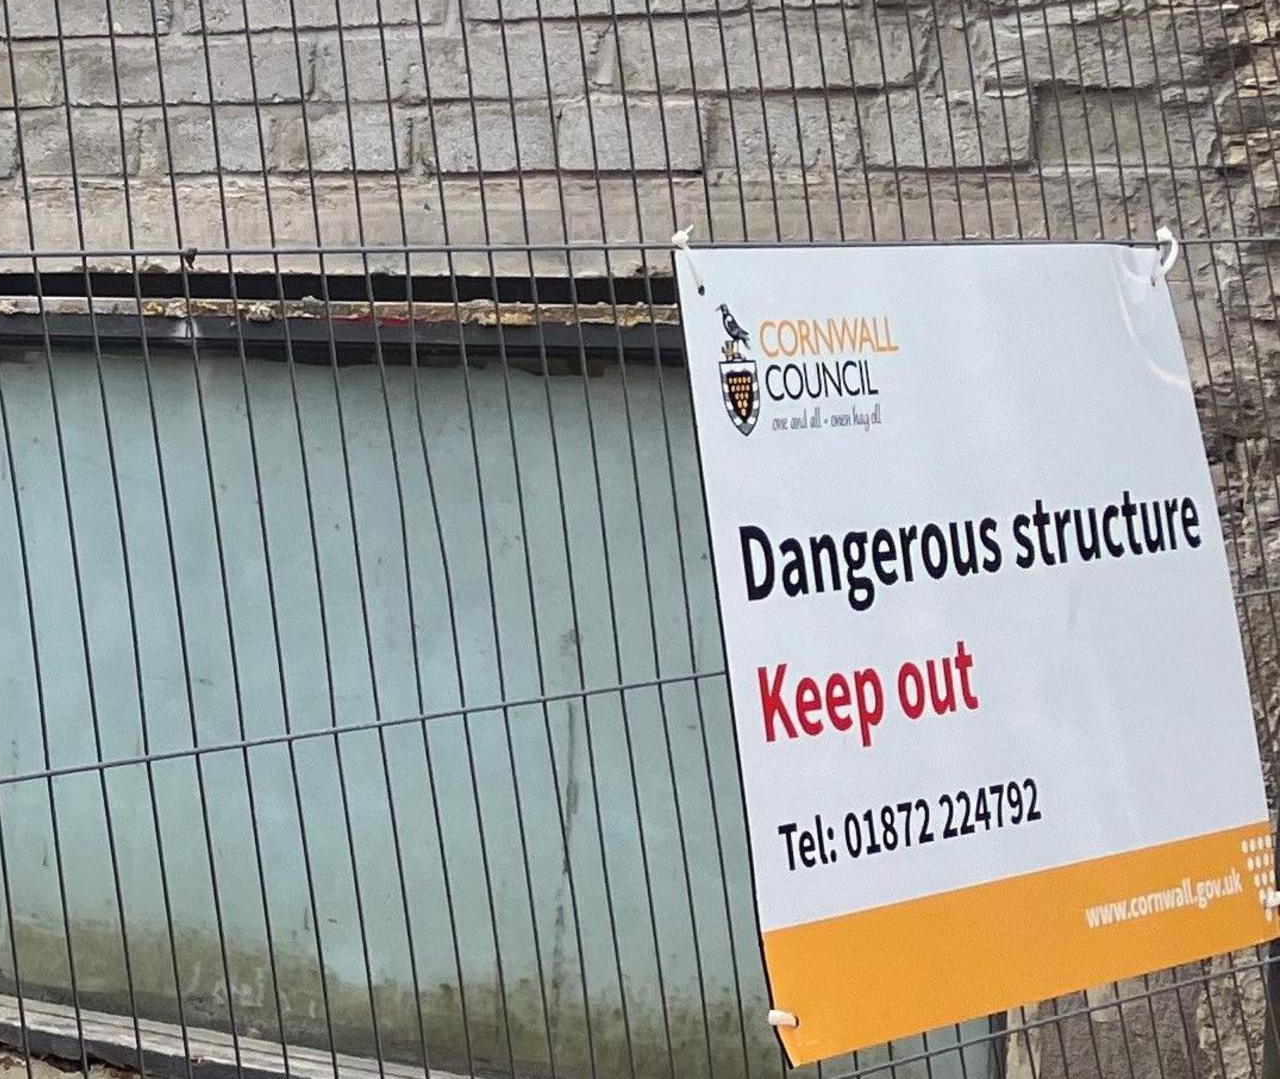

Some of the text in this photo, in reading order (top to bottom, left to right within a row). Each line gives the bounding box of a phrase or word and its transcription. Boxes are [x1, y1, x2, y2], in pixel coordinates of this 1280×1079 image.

[759, 316, 899, 358] CORNWALL
[765, 360, 879, 401] COUNCIL
[739, 491, 1202, 611] Dangerous structure
[757, 640, 979, 747] Keep out
[778, 778, 1042, 870] Tel: 01872 224792
[1085, 868, 1243, 929] www.cornwall.gov.uk
